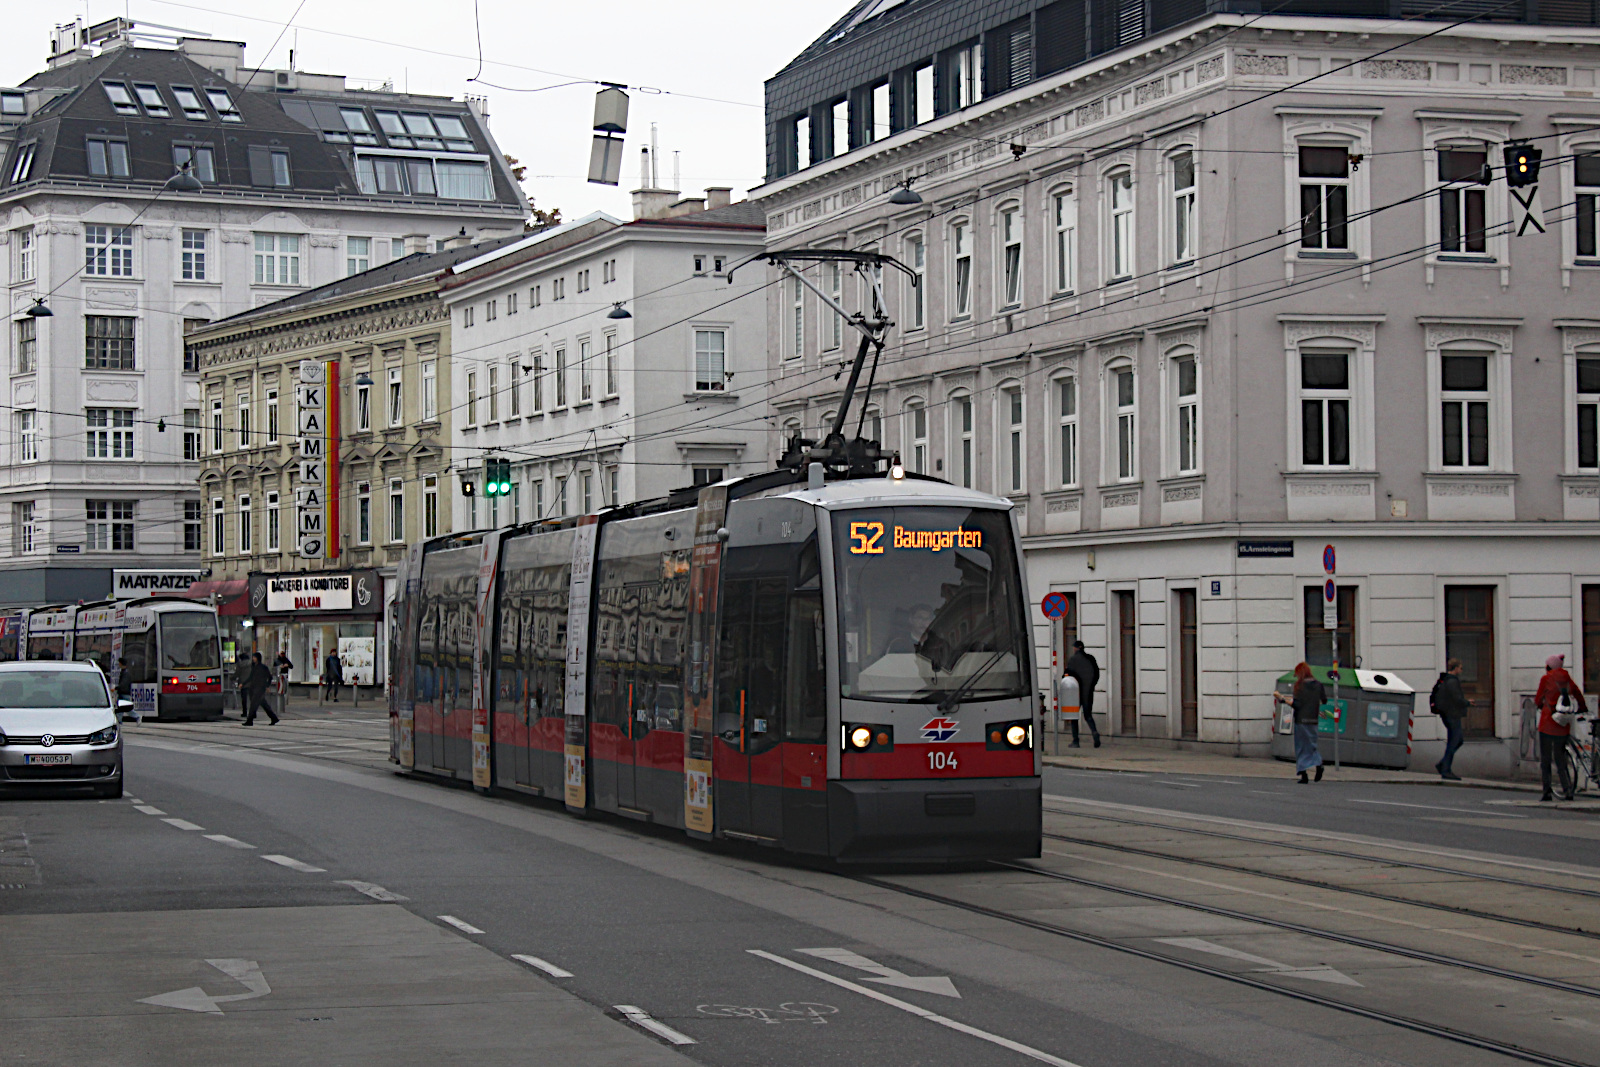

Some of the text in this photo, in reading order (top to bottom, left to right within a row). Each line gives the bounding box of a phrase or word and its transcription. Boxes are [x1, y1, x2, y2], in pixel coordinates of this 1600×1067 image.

[305, 389, 321, 530] KAMKAM
[850, 522, 982, 554] 52 Baumgarten
[295, 596, 321, 609] BALKAN
[927, 751, 958, 770] 104
